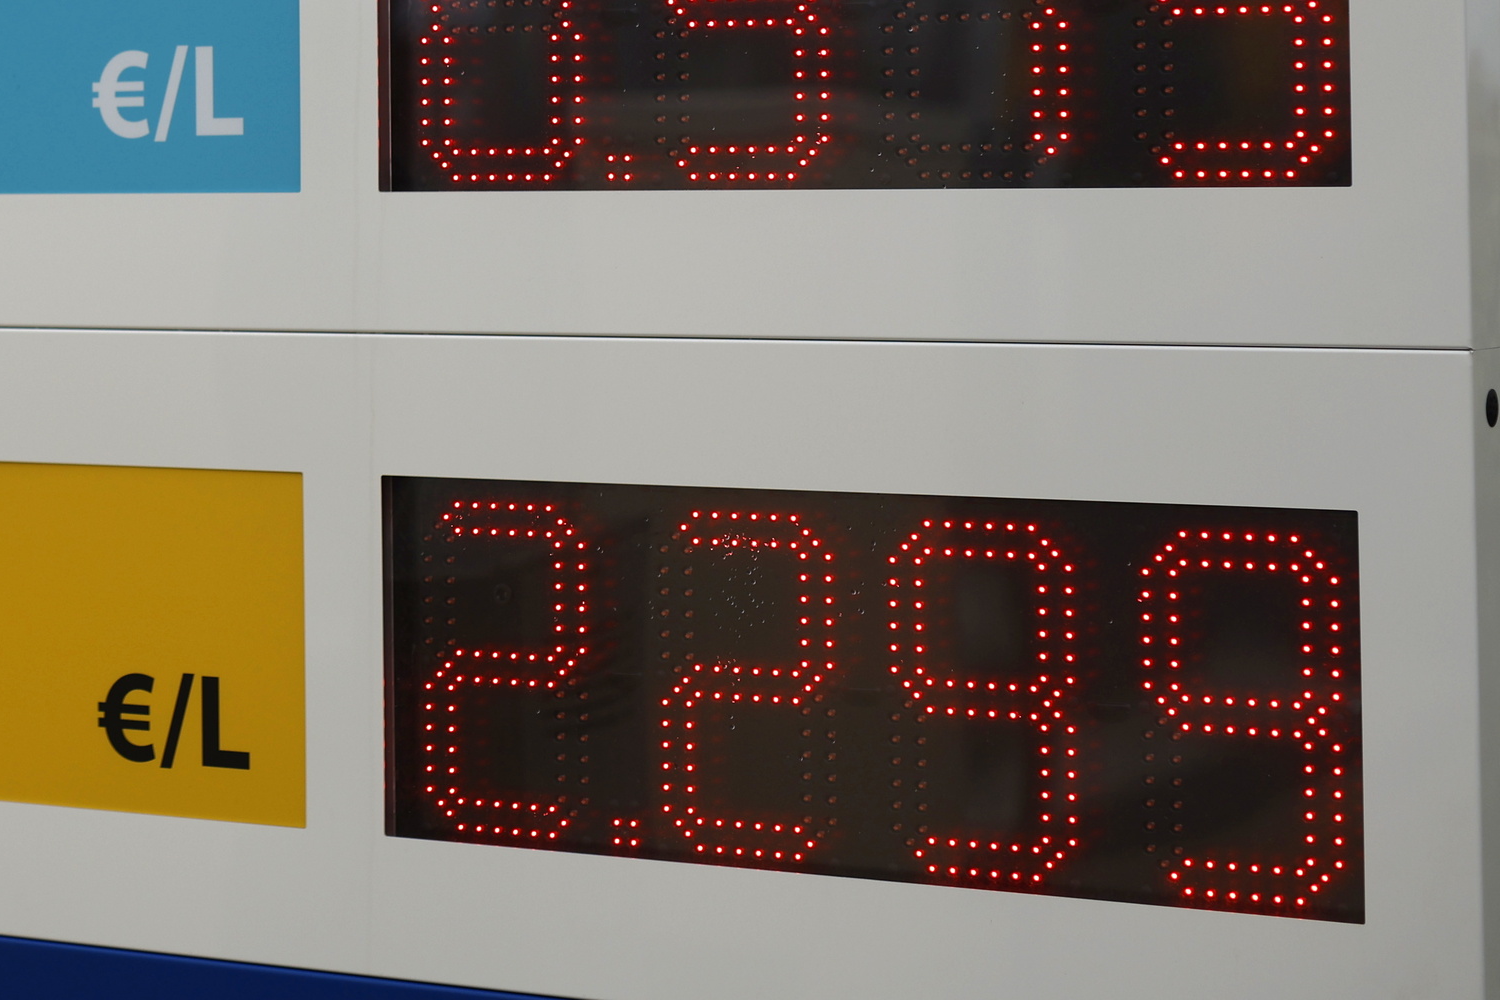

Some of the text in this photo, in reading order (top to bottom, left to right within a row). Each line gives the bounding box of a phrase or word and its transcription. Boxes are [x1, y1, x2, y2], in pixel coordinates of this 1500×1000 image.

[92, 45, 244, 142] €/L
[97, 672, 251, 771] €/L
[425, 501, 1342, 906] 2.299
